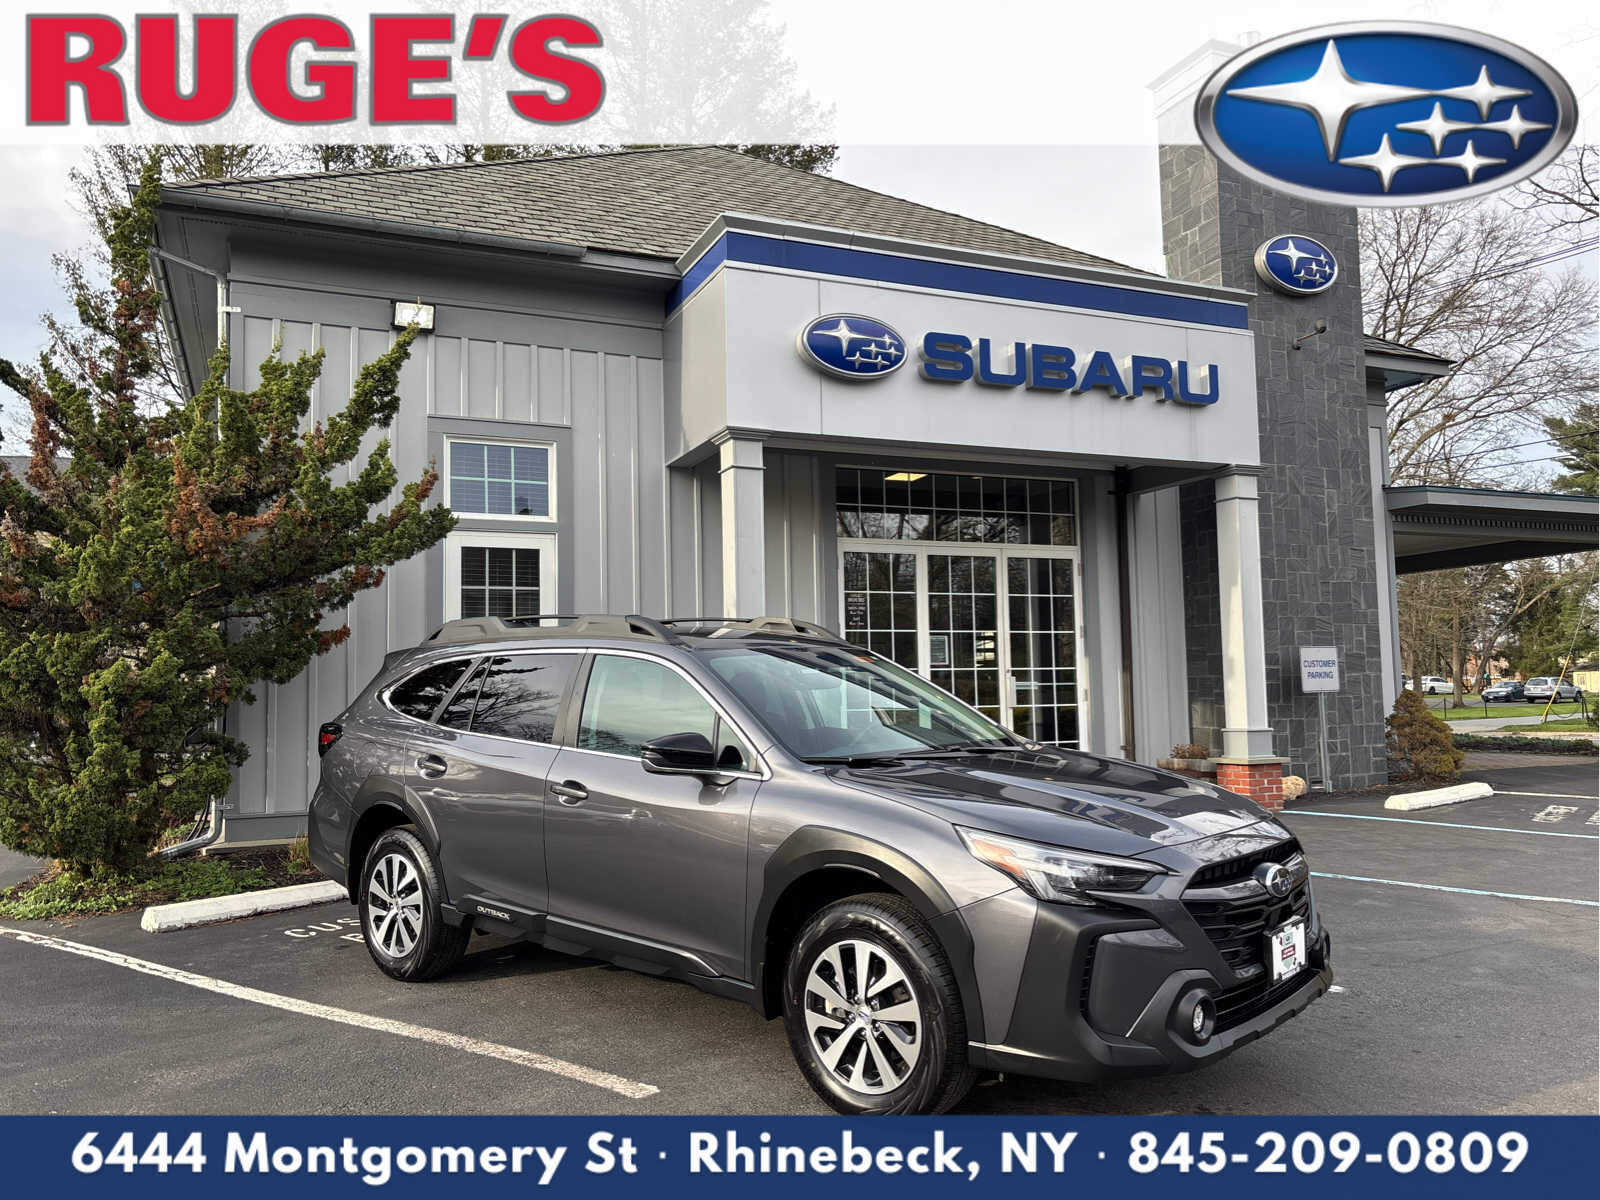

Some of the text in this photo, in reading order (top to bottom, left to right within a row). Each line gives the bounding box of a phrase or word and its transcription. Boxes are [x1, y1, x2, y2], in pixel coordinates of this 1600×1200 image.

[920, 332, 1220, 405] SUBARU
[1303, 660, 1337, 668] CUSTOMER
[1307, 671, 1334, 679] PARKING
[476, 905, 511, 920] OUTBACK
